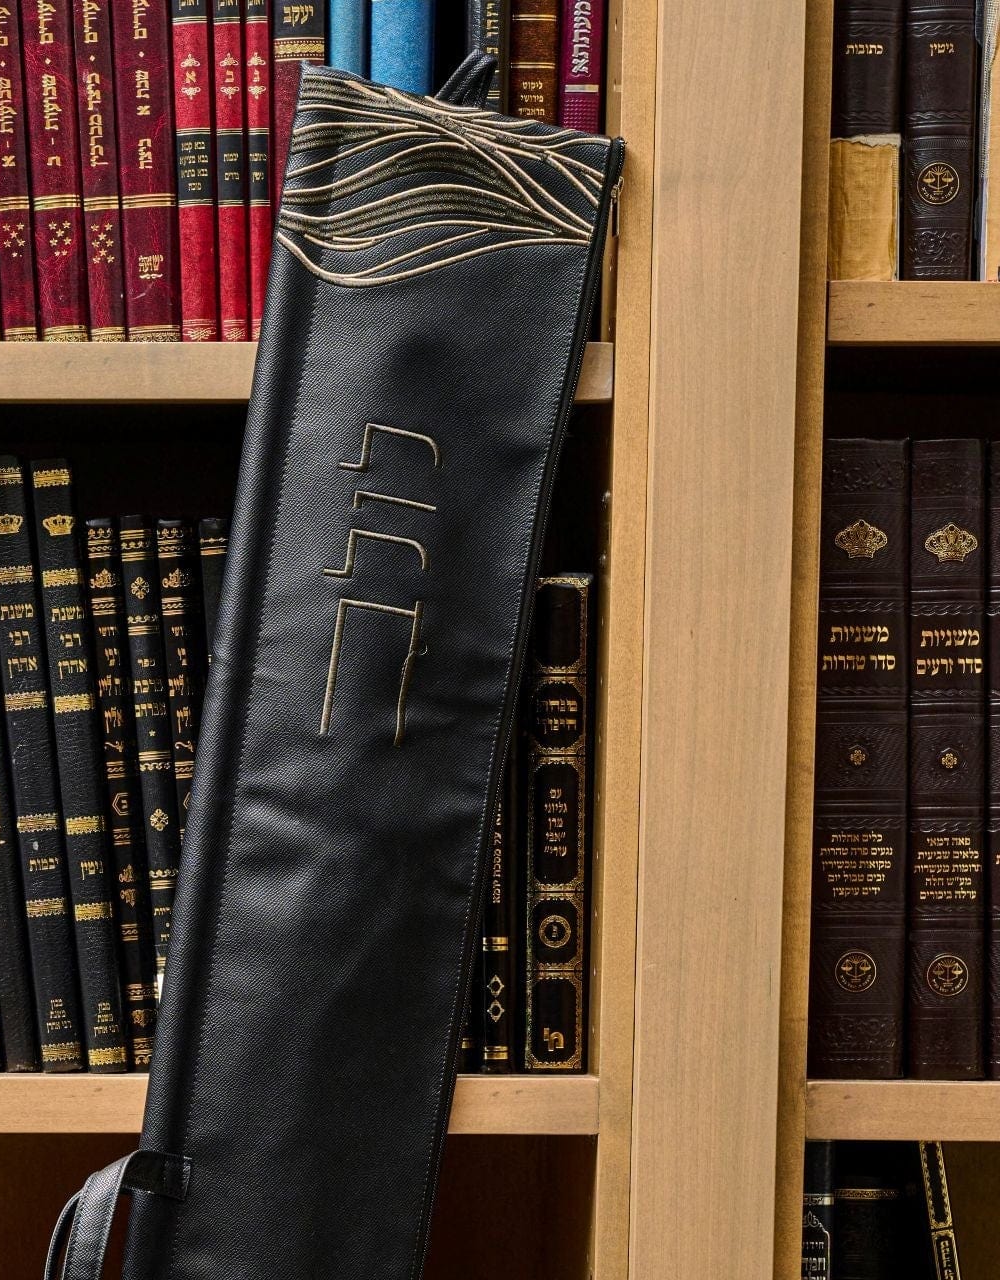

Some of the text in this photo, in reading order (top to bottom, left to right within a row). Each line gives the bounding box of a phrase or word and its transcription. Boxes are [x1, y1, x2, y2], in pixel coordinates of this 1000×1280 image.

[283, 5, 313, 27] יעקב
[846, 44, 883, 54] כתובות
[930, 43, 954, 56] גיטין
[185, 70, 196, 84] א
[225, 70, 234, 82] ב
[253, 69, 260, 82] ג
[1, 604, 33, 620] משנת
[9, 631, 30, 645] רבי
[831, 626, 889, 642] משניות
[921, 629, 979, 647] משניות
[8, 656, 37, 678] אהרן
[823, 655, 895, 670] סדר טהרות
[917, 658, 982, 675] סדר זרעים
[548, 818, 563, 830] מרן
[832, 831, 882, 842] כלים אהלות
[30, 857, 58, 871] יבמות
[81, 861, 103, 880] גיטין
